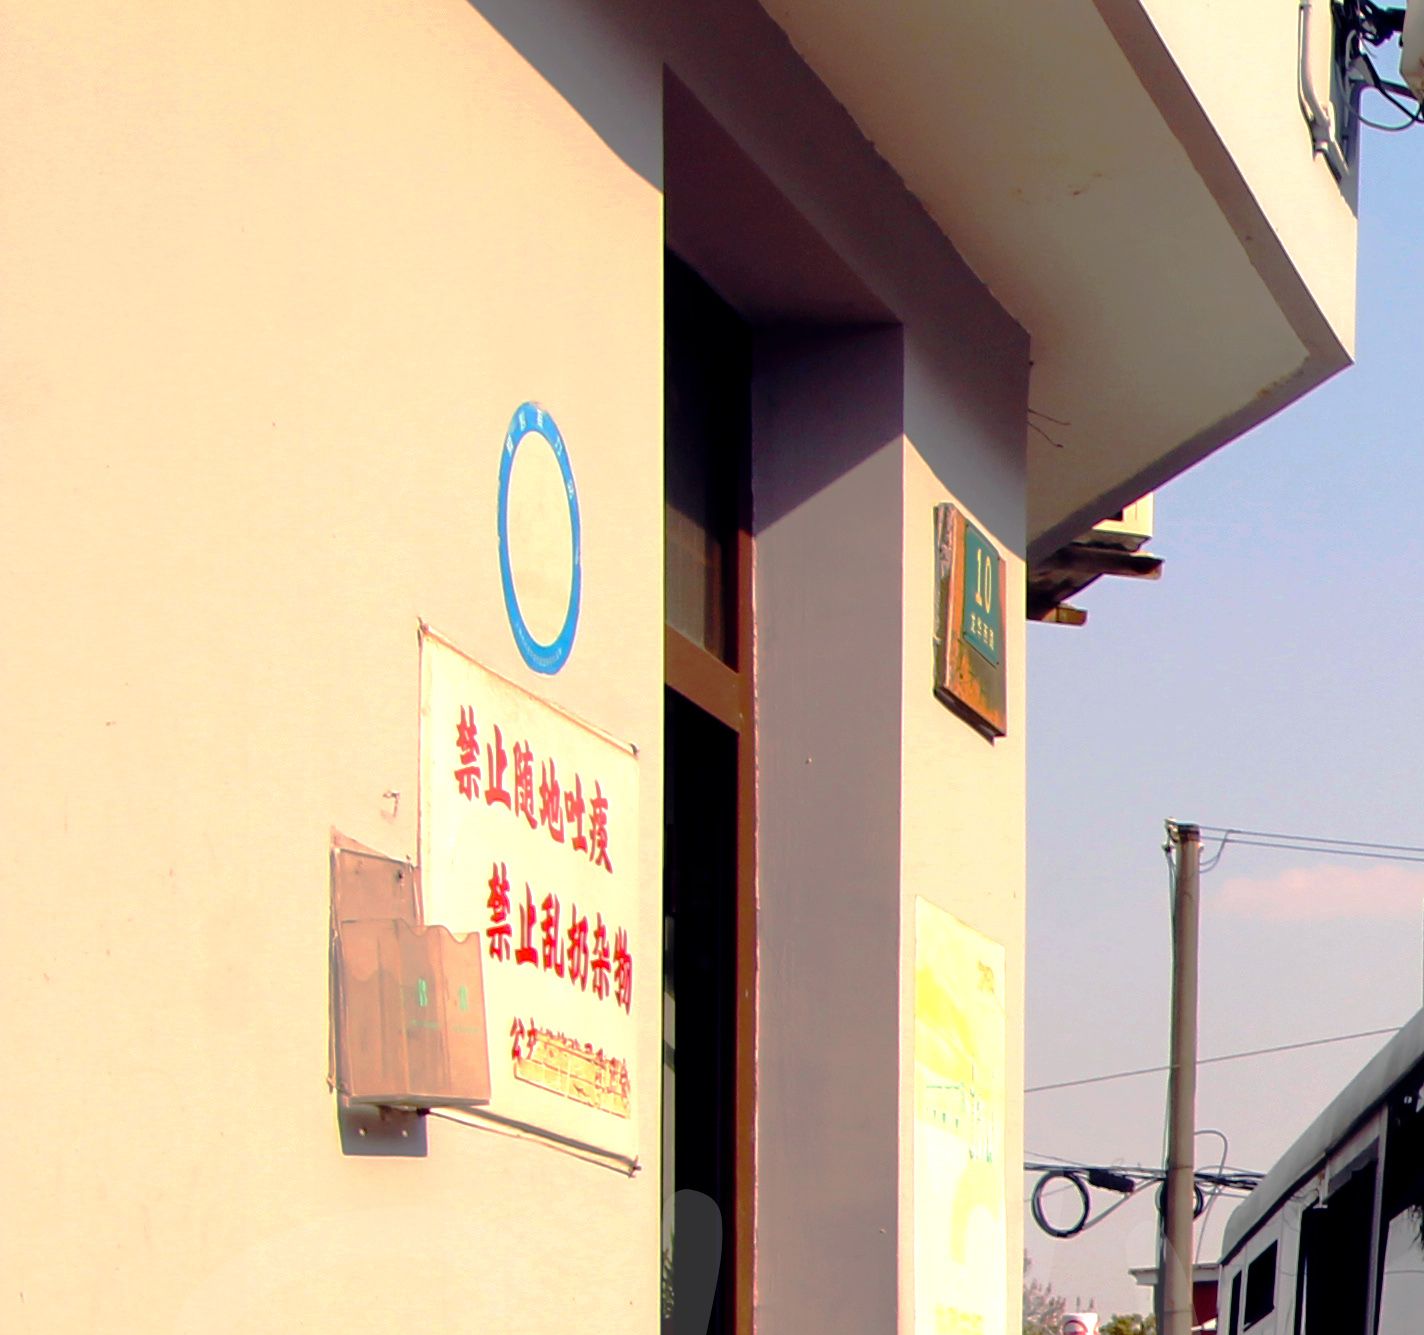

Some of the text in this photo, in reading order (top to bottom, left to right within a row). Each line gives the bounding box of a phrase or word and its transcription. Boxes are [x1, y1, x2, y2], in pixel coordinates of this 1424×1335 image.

[975, 548, 992, 614] 10
[454, 704, 613, 874] 禁止随地吐痰
[486, 861, 633, 1016] 禁止乱扔杂物
